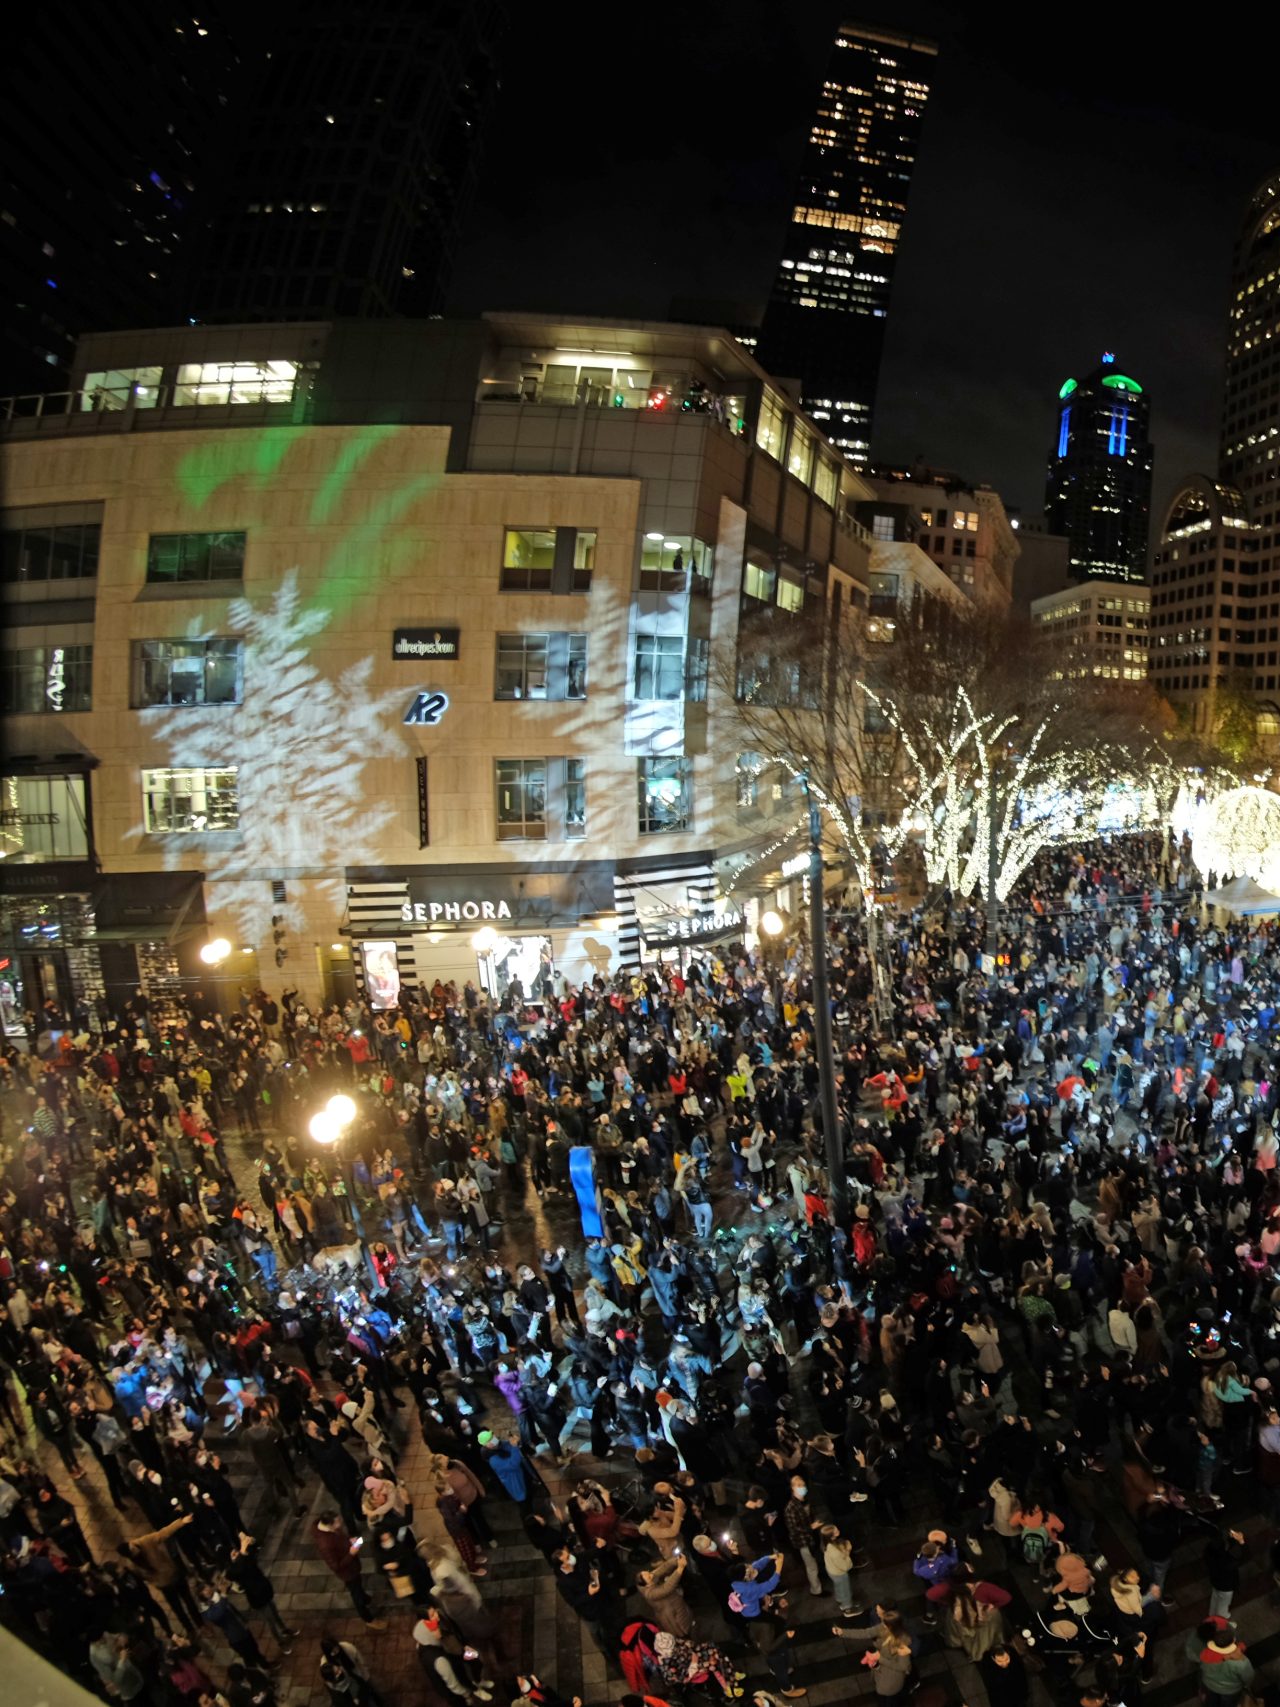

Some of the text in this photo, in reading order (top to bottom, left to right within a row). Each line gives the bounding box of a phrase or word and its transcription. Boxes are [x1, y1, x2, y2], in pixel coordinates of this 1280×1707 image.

[402, 692, 449, 725] K2
[401, 900, 512, 921] SEPHORA
[667, 912, 741, 937] SEPHORA
